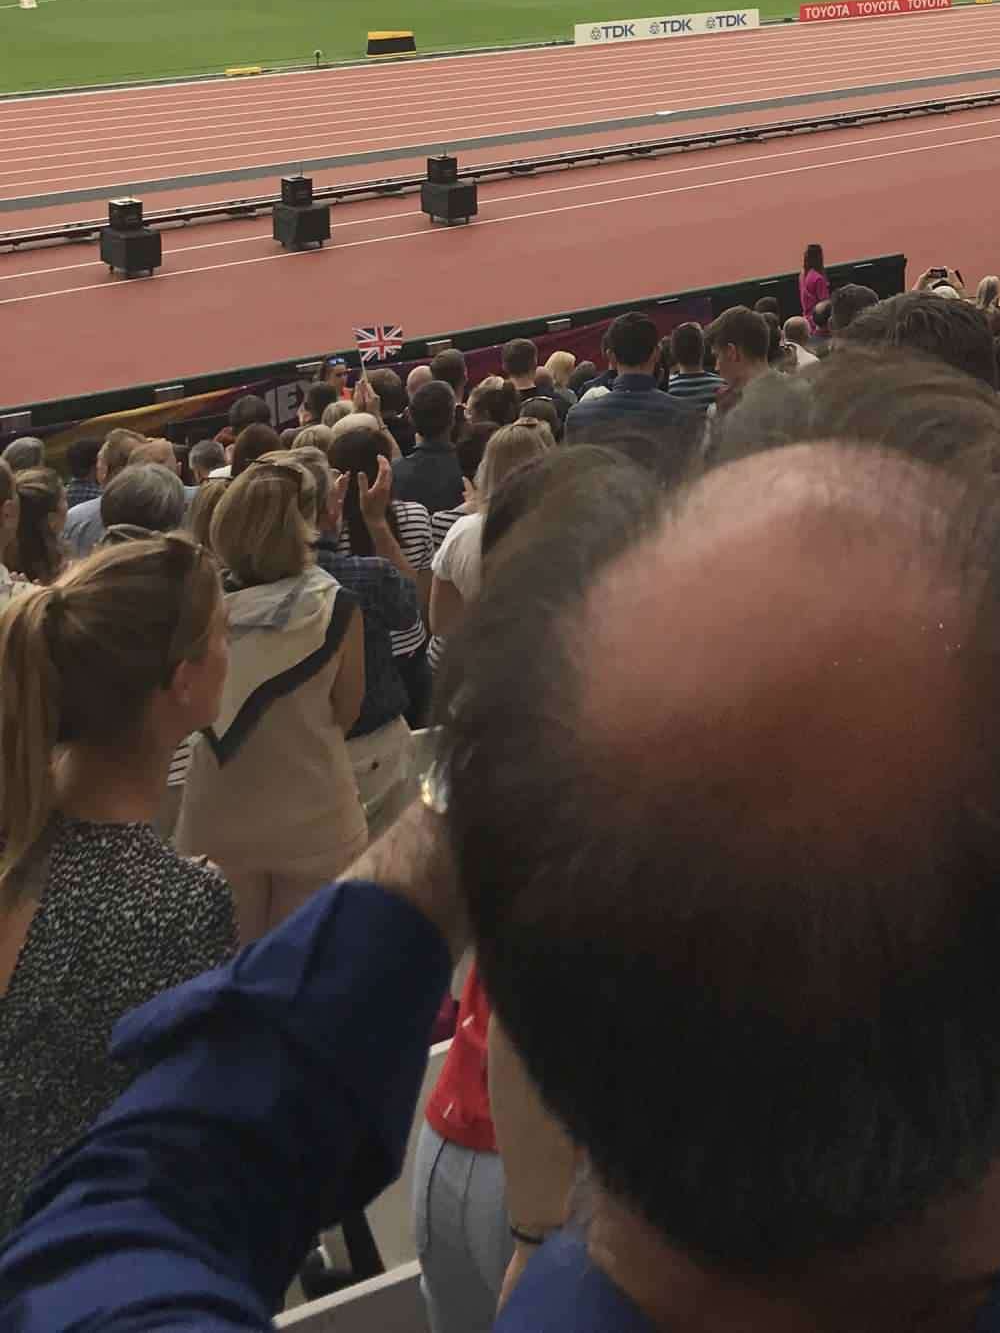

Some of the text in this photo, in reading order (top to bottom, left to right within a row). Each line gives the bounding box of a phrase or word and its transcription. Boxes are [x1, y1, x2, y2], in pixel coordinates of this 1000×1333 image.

[804, 5, 850, 19] TOYOTA
[857, 0, 900, 13] TOYOTA
[601, 13, 747, 40] TDK TDK TDK
